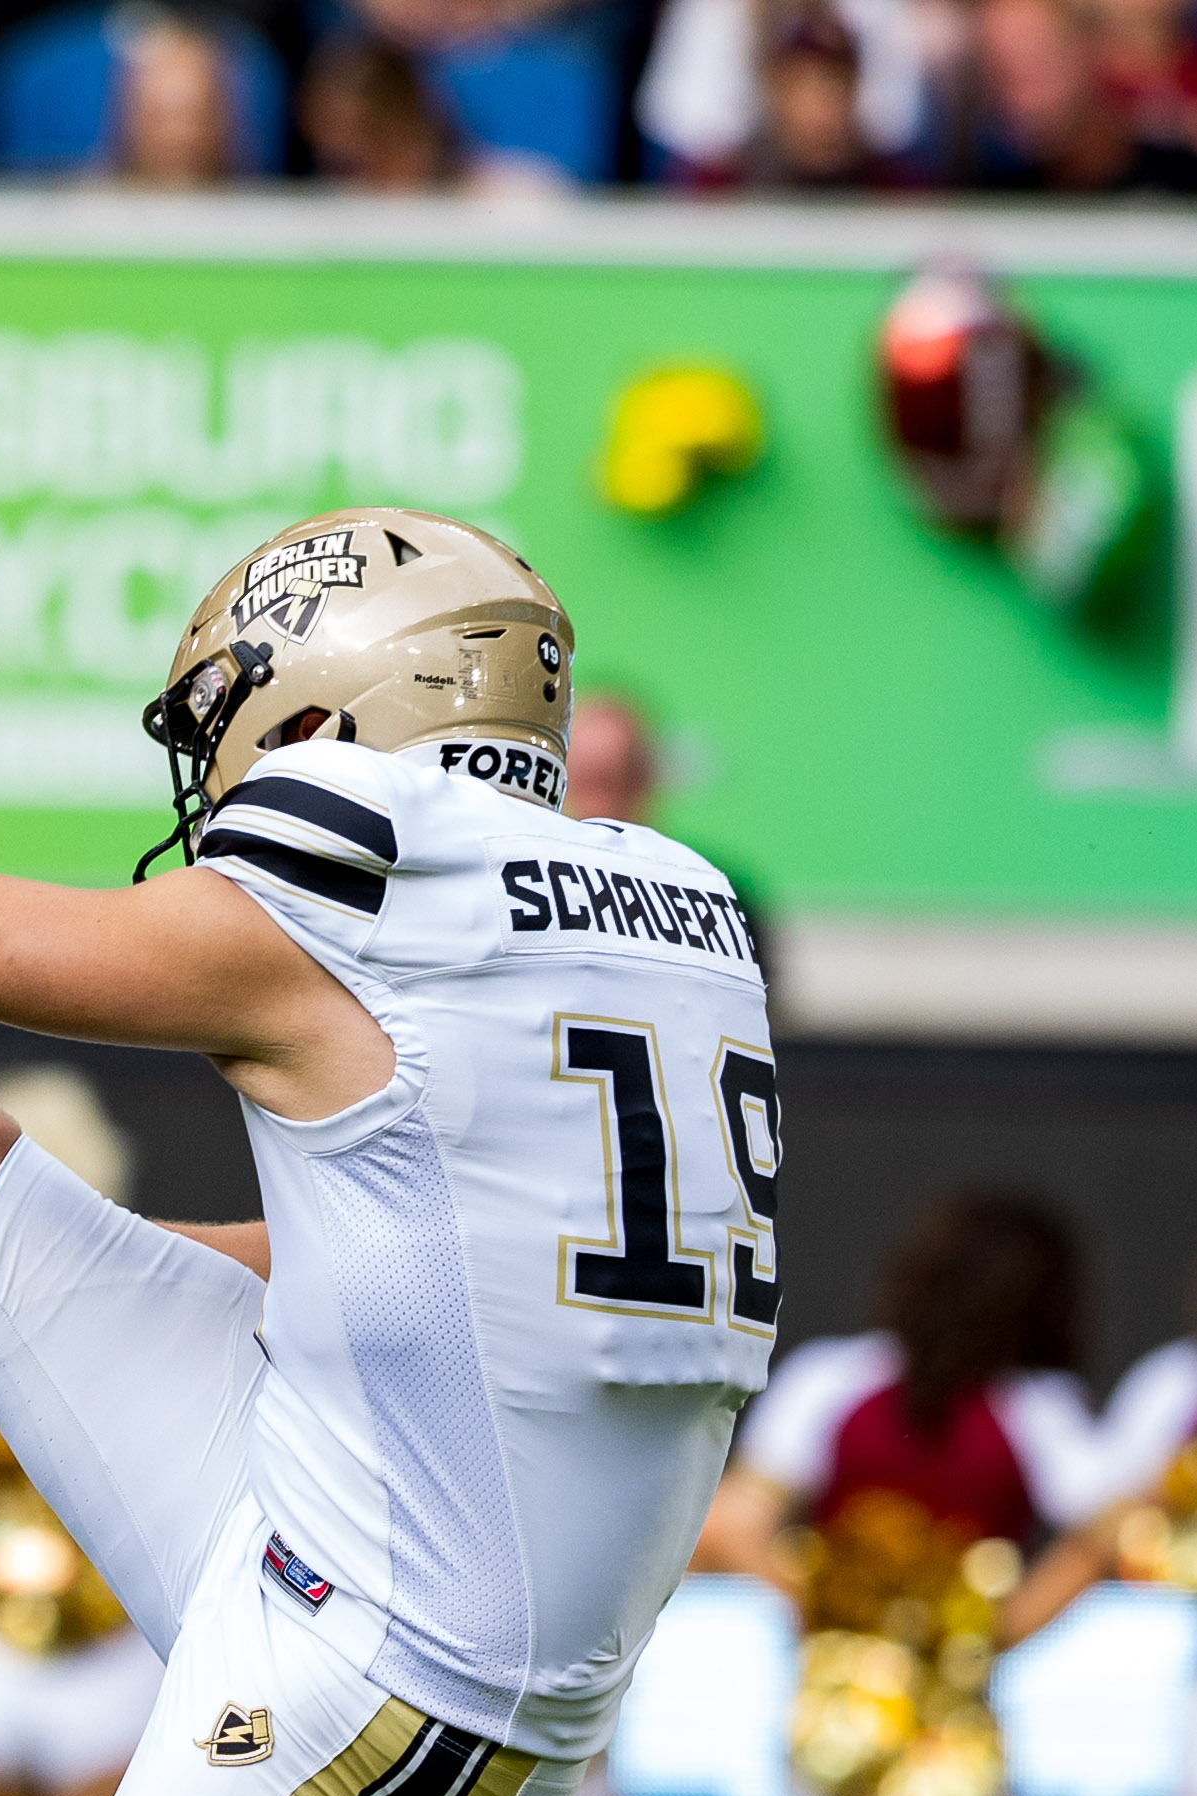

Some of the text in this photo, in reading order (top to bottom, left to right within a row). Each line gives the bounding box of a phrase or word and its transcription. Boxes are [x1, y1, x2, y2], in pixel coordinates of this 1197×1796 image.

[238, 556, 360, 624] THUNDER
[247, 532, 348, 590] BERLIN
[414, 673, 455, 685] Riddell
[540, 641, 559, 665] 19
[439, 743, 565, 806] FOREL
[550, 1011, 777, 1340] 19
